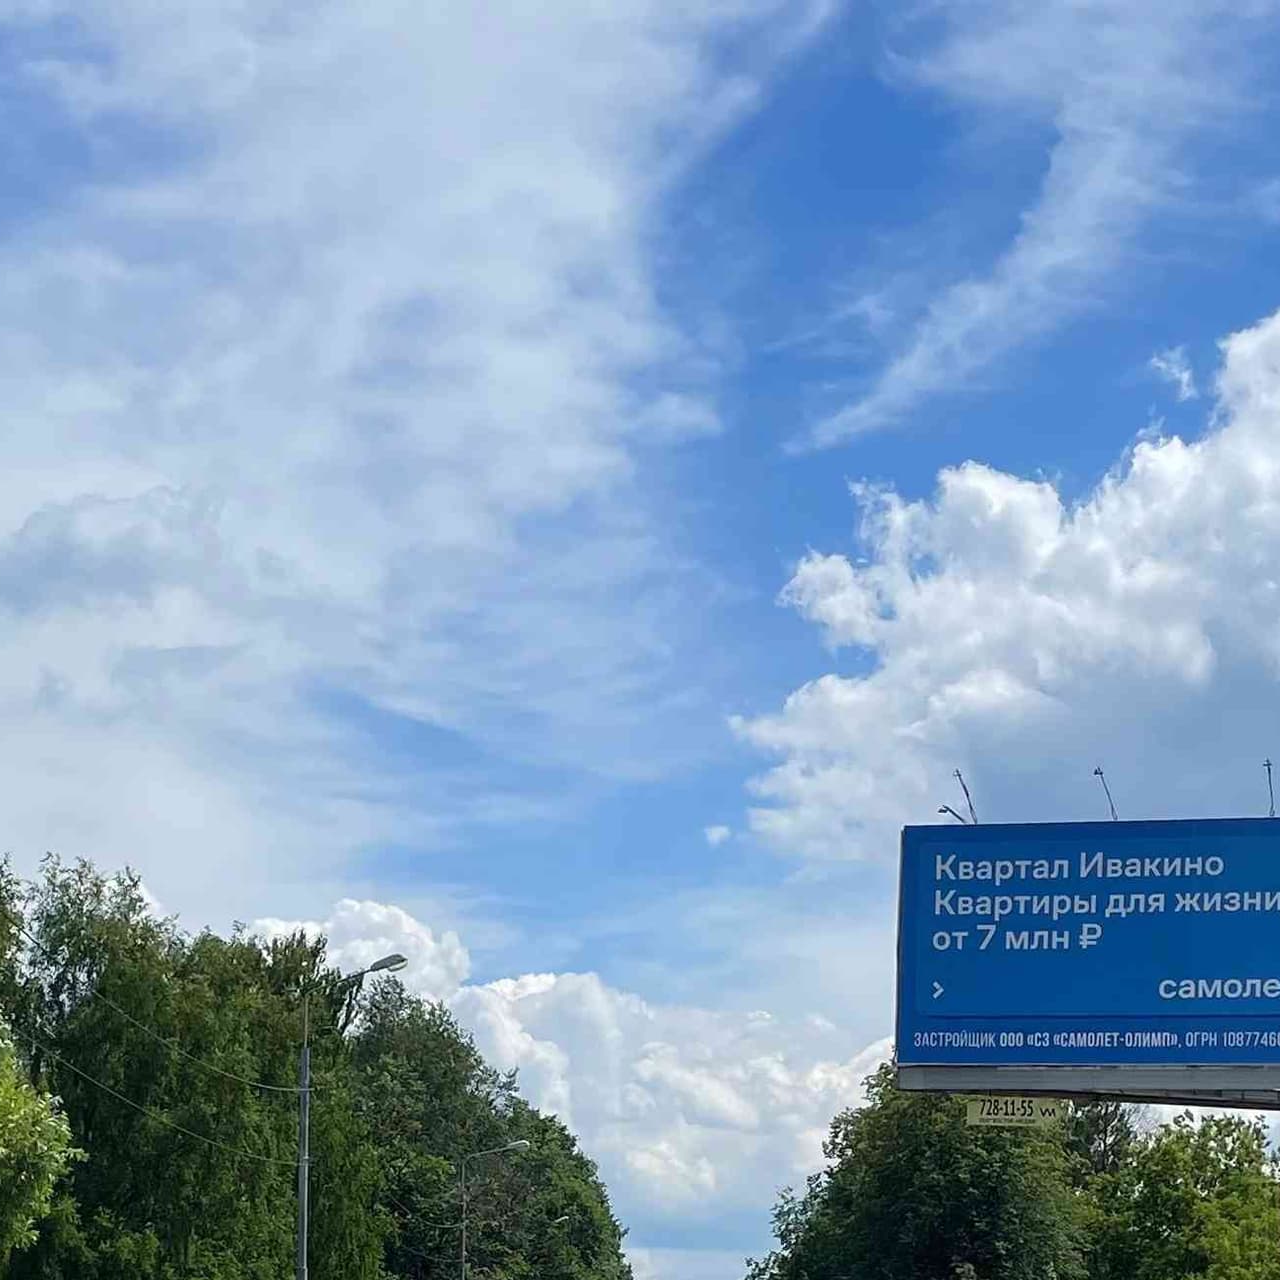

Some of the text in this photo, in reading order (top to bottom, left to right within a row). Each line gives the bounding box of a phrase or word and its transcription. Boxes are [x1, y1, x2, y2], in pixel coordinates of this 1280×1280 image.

[935, 852, 1224, 886] Квартал Ивакино
[934, 889, 1097, 921] Квартиры
[1104, 893, 1165, 917] для
[932, 931, 969, 950] от
[976, 924, 997, 950] 7
[1005, 930, 1069, 950] млн
[913, 1030, 996, 1048] ЗАСТРОЙЩИК
[999, 1032, 1023, 1047] ООО
[1053, 1031, 1182, 1048] «САМОЛЕТ-ОЛИМП»,
[1185, 1031, 1218, 1047] ОГРН
[980, 1099, 1033, 1117] 728-11-55
